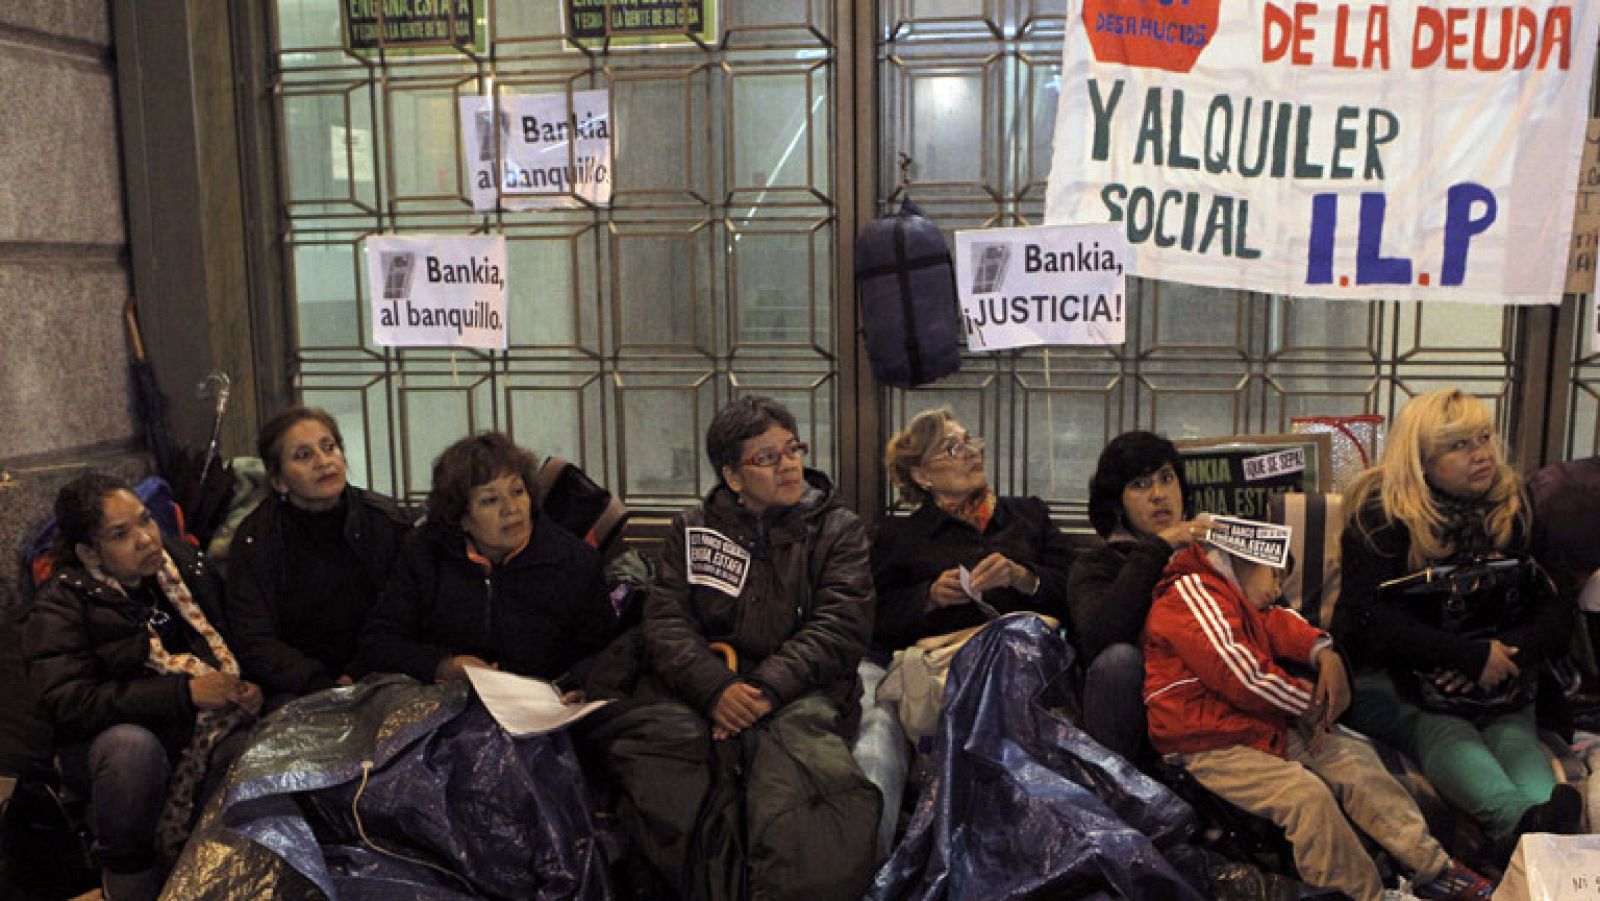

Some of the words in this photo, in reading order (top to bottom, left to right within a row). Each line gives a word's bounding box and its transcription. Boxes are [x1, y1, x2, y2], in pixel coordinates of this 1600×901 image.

[1262, 2, 1318, 65] DE
[1333, 4, 1390, 71] LA
[1411, 6, 1572, 72] DEUDA
[1087, 79, 1125, 161] Y
[1133, 86, 1399, 180] ALQUILER
[1100, 183, 1262, 259] SOCIAL
[426, 256, 505, 291] Bankia,
[1024, 242, 1123, 276] Bankia,
[380, 300, 401, 327] al
[407, 301, 503, 336] banquillo.
[964, 293, 1122, 335] ¡JUSTICIA!
[1184, 458, 1232, 484] NKIA
